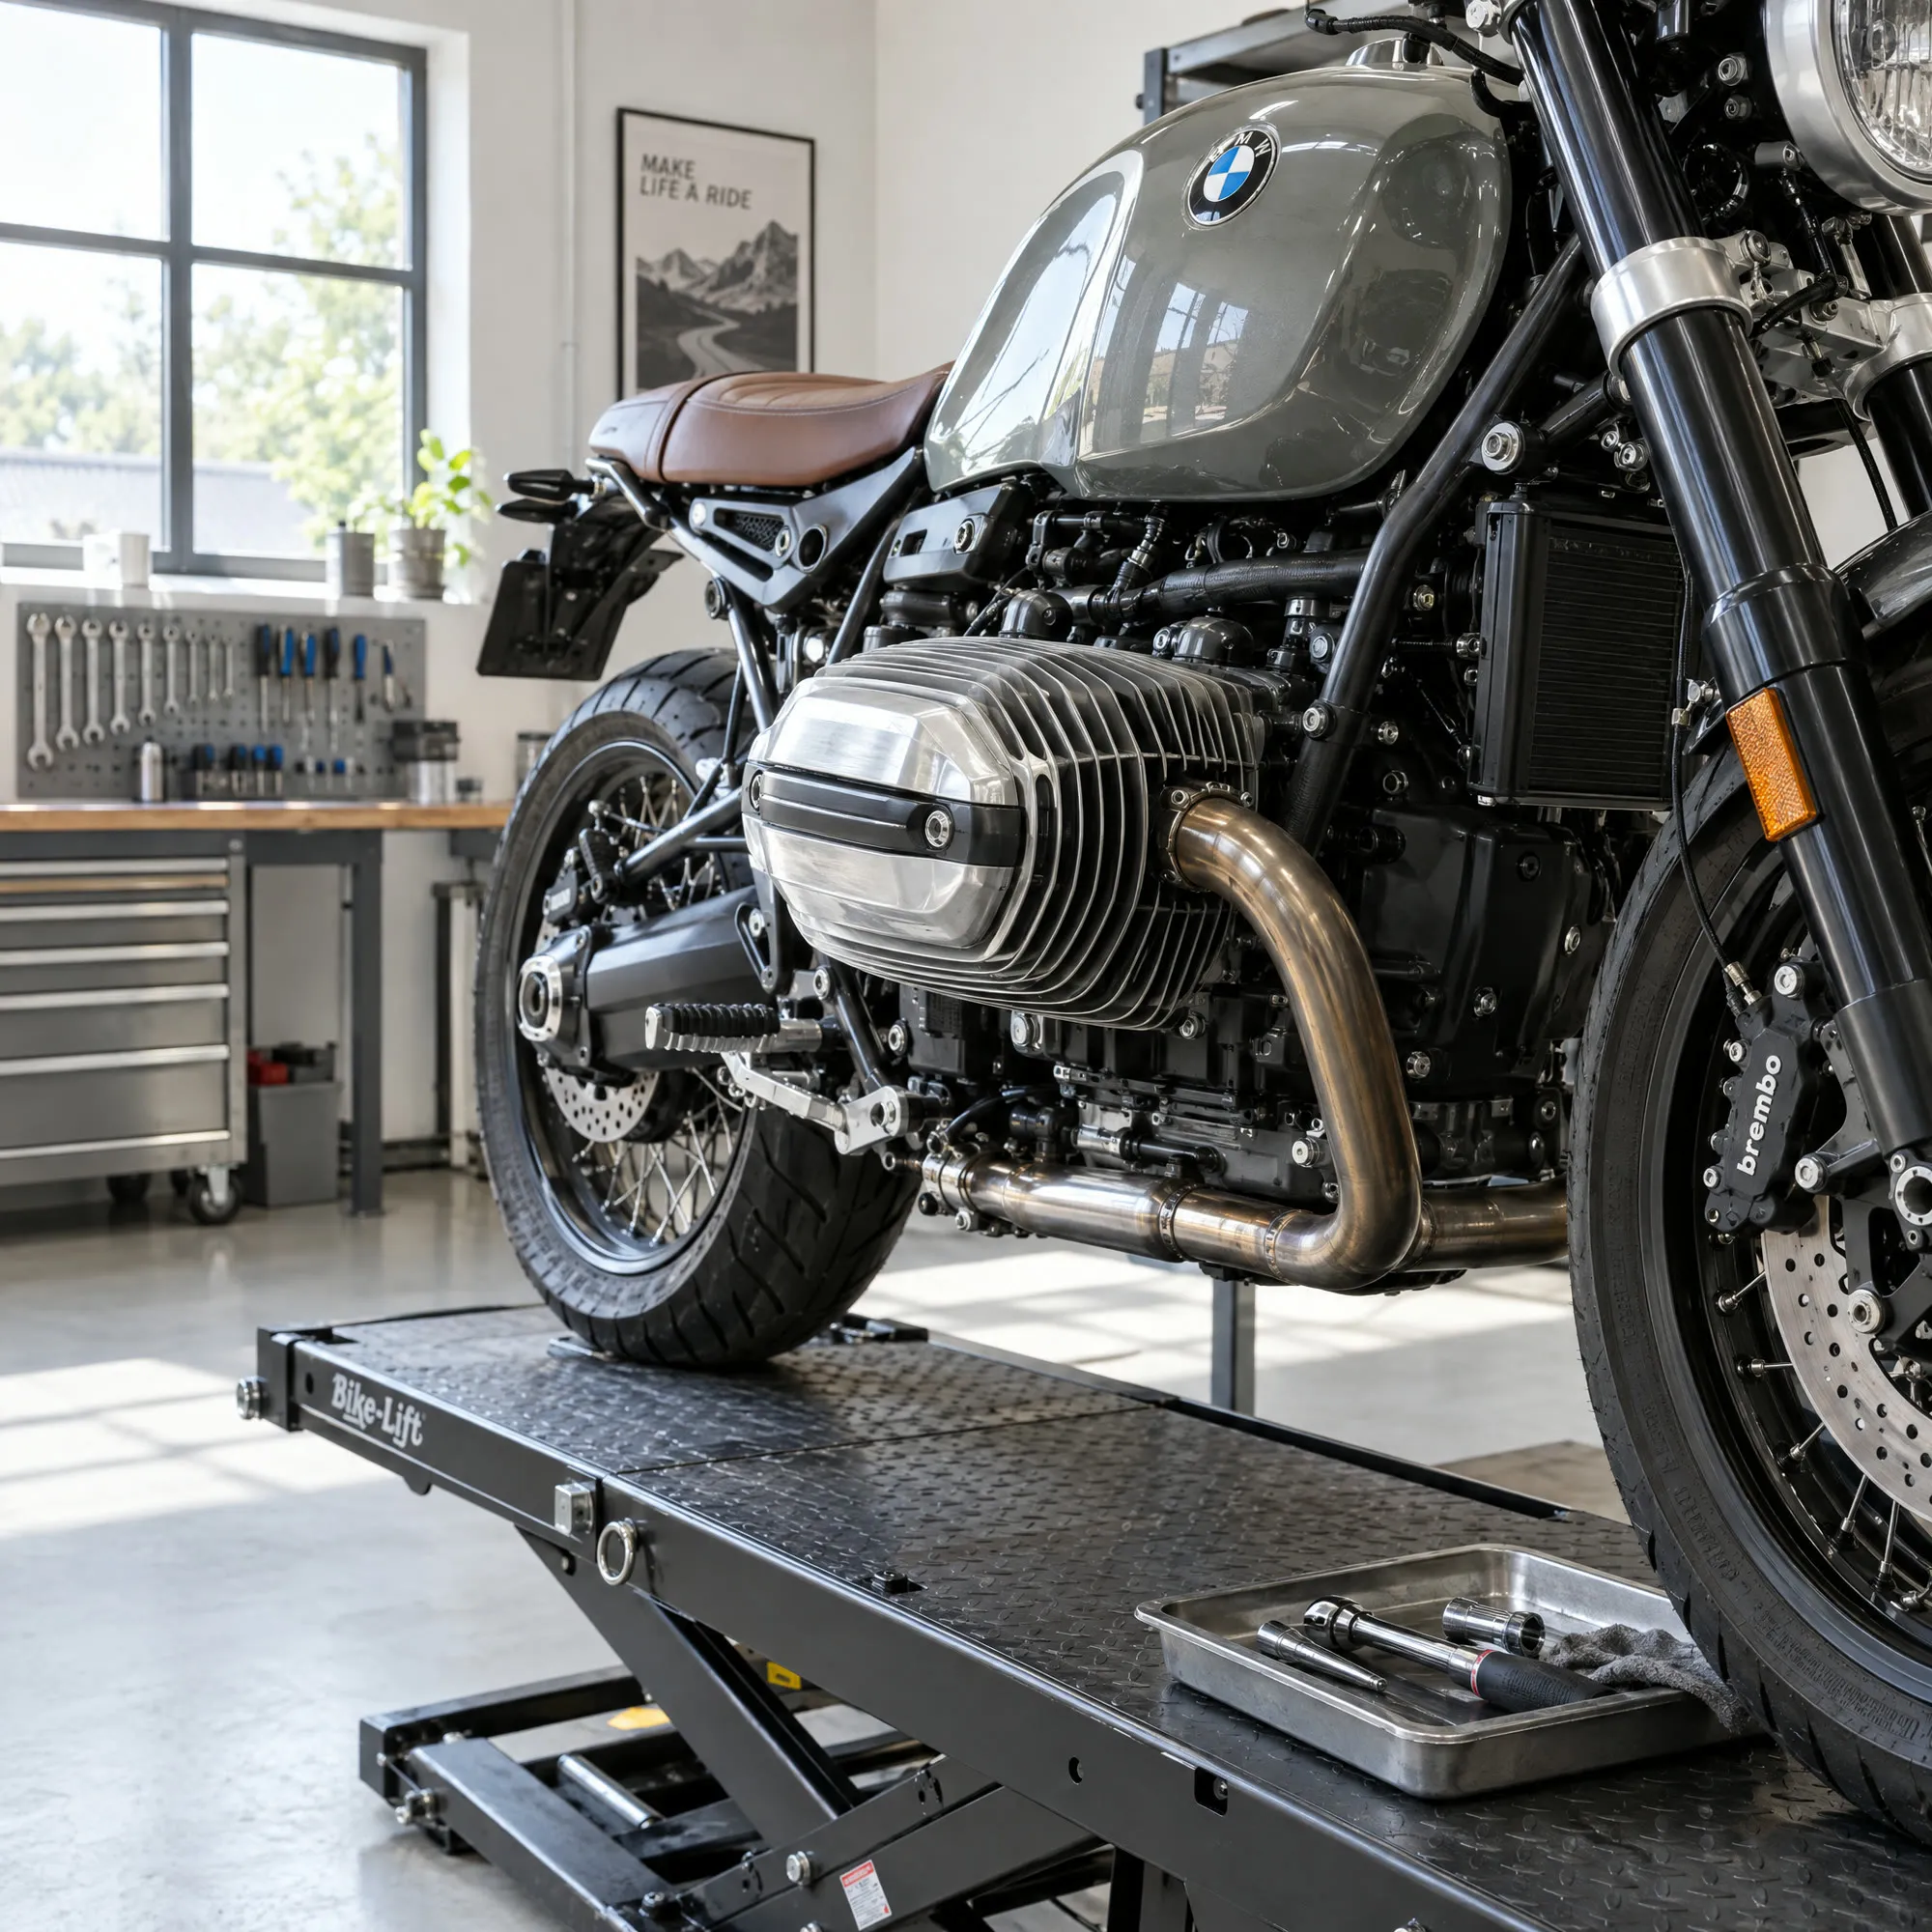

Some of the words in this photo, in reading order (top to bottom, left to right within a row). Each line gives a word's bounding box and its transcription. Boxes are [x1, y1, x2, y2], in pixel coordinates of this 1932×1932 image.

[639, 176, 679, 200] LIFE
[685, 183, 699, 202] A
[705, 185, 753, 210] RIDE
[641, 154, 696, 180] MAKE
[1737, 1055, 1781, 1176] brembo
[331, 1373, 423, 1448] Bike-Lift
